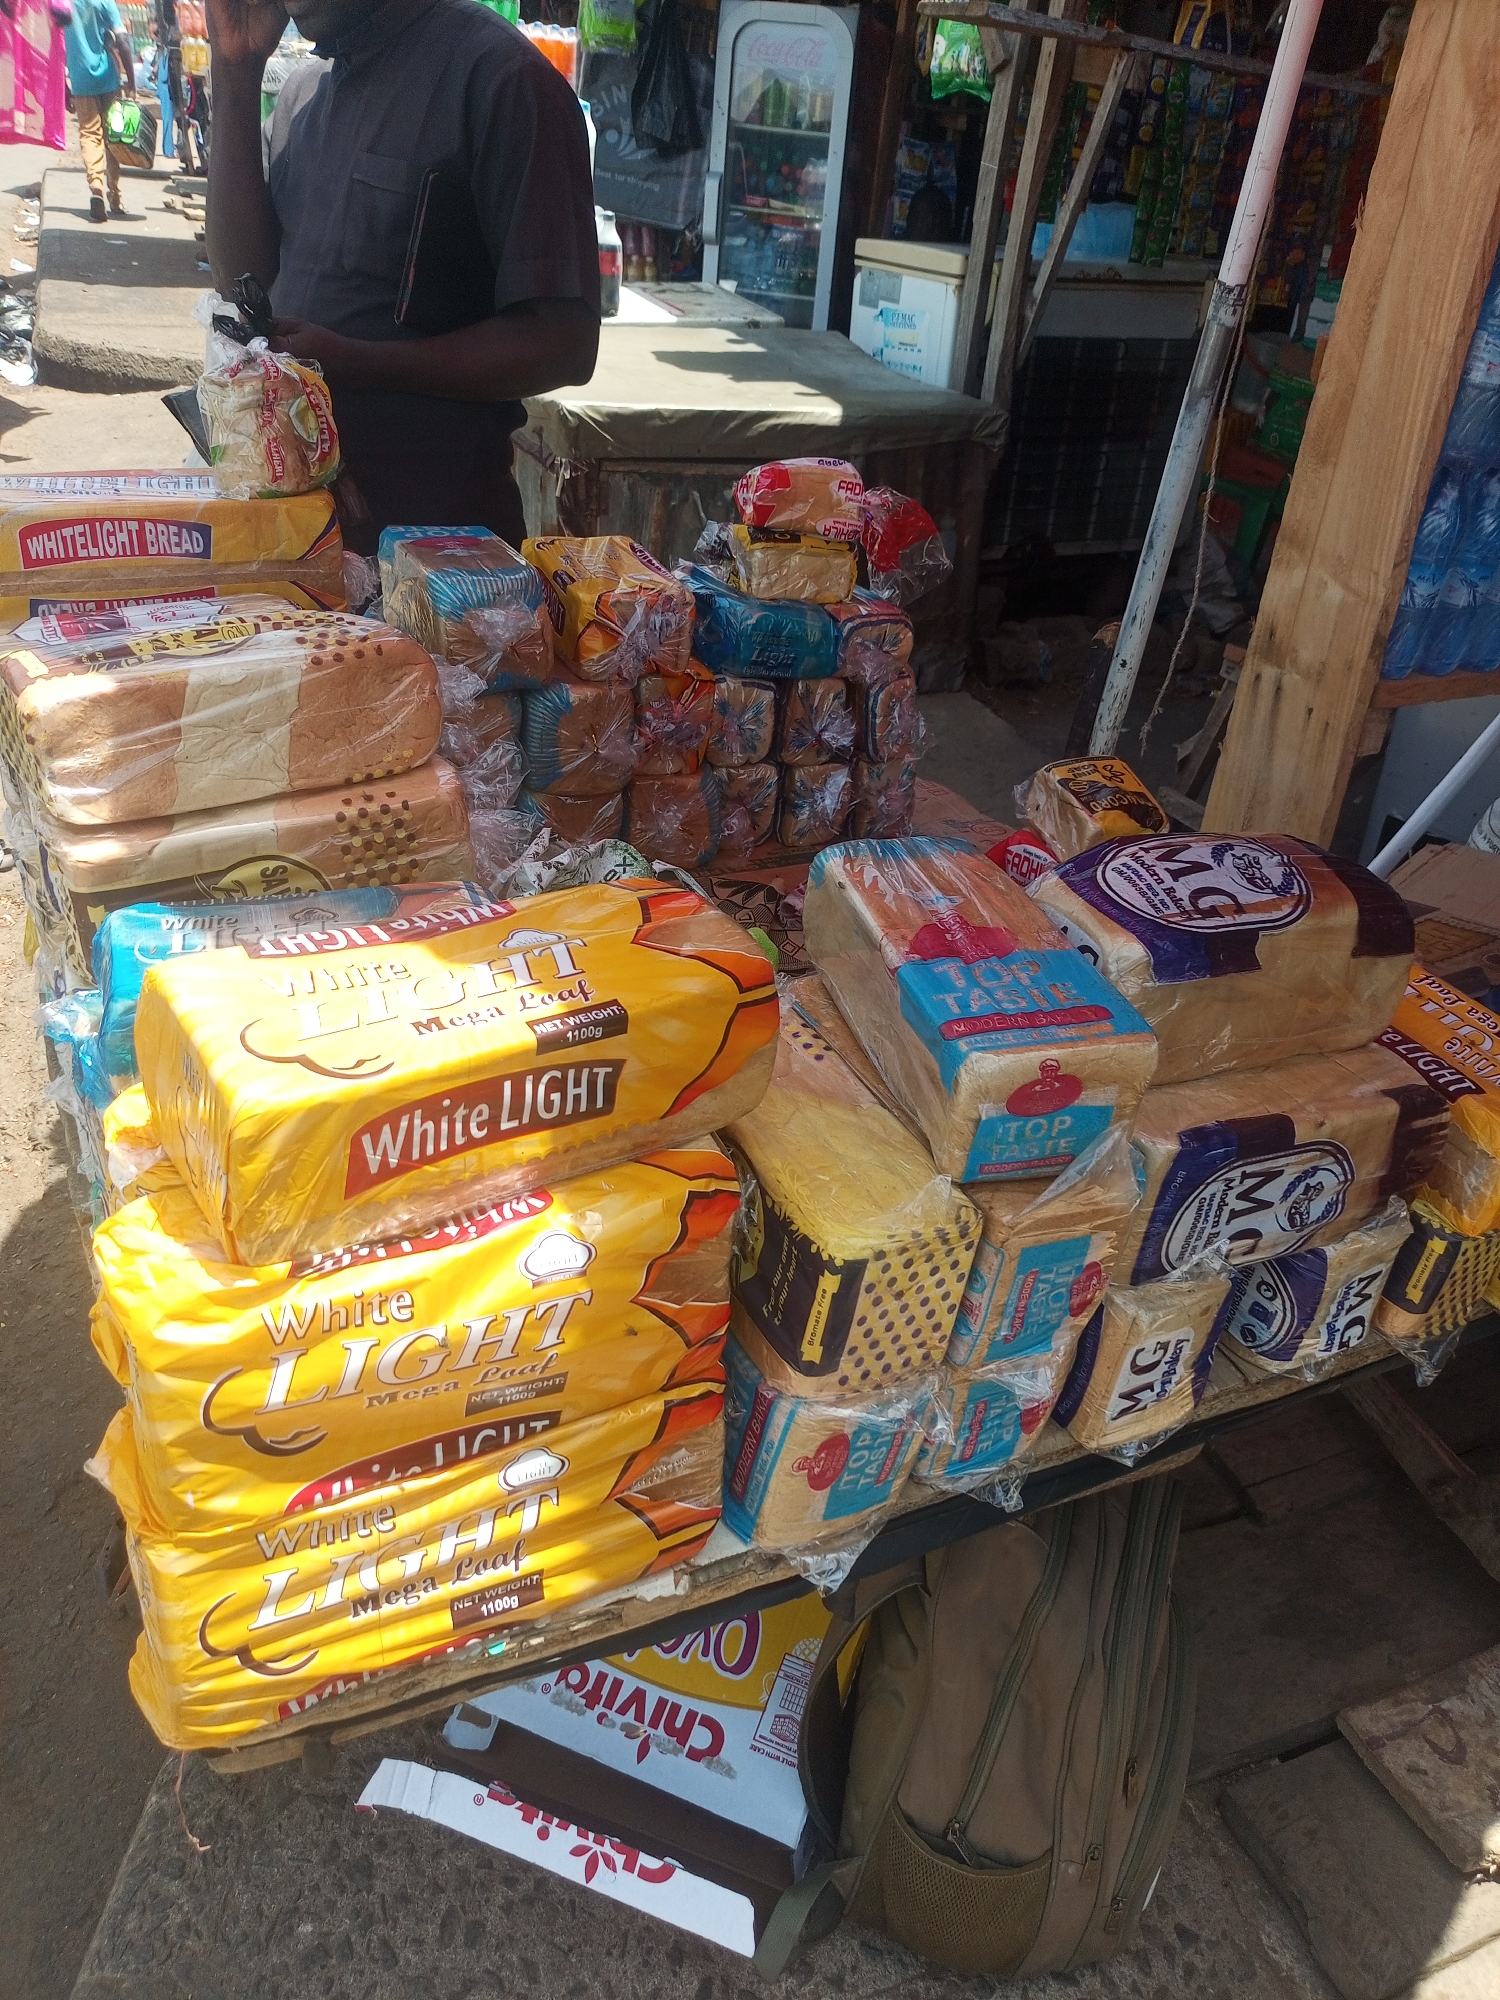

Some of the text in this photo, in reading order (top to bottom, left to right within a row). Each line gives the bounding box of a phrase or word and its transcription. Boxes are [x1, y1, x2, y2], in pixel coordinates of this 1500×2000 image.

[268, 438, 285, 478] ALHERI
[26, 519, 205, 560] WHITELIGHT BREAD
[1126, 851, 1166, 887] Modern
[259, 901, 512, 957] White LIGHT
[260, 958, 414, 997] White
[296, 936, 590, 1042] LIGHT
[932, 960, 1043, 989] TOP
[1413, 973, 1466, 1007] Loaf
[409, 977, 596, 1036] Mega Loaf
[932, 982, 1087, 1015] TASTE
[532, 1004, 627, 1035] NET WEIGHT:
[566, 1024, 605, 1043] 1100g
[951, 1016, 1030, 1035] MODERN
[1395, 1043, 1477, 1093] LIGHT
[361, 1066, 614, 1175] White LIGHT
[1006, 1116, 1073, 1143] TOP
[983, 1155, 1073, 1175] MODERN BAKERY
[991, 1137, 1078, 1161] TASTE
[1210, 1177, 1237, 1230] Modern
[786, 1245, 799, 1283] heart
[1016, 1274, 1035, 1312] MODERN
[1338, 1268, 1384, 1351] MG
[260, 1289, 415, 1346] White
[807, 1287, 828, 1347] Bromate Free
[254, 1287, 595, 1416] LIGHT
[1163, 1338, 1191, 1379] Bakery
[364, 1350, 560, 1410] Mega Loaf
[470, 1375, 567, 1404] NET WEIGHT:
[497, 1388, 538, 1407] 1100g
[1110, 1339, 1172, 1422] MG
[732, 1390, 773, 1496] MODERN BAKE
[840, 1431, 872, 1490] TOP
[256, 1502, 396, 1560] White
[246, 1487, 559, 1631] LIGHT
[350, 1537, 529, 1619] Mega Loaf
[453, 1573, 542, 1611] NET WEIGHT:
[480, 1594, 520, 1618] 1100g
[554, 1662, 725, 1763] Chivita
[749, 1743, 766, 1756] CARE
[764, 1751, 782, 1763] WITH
